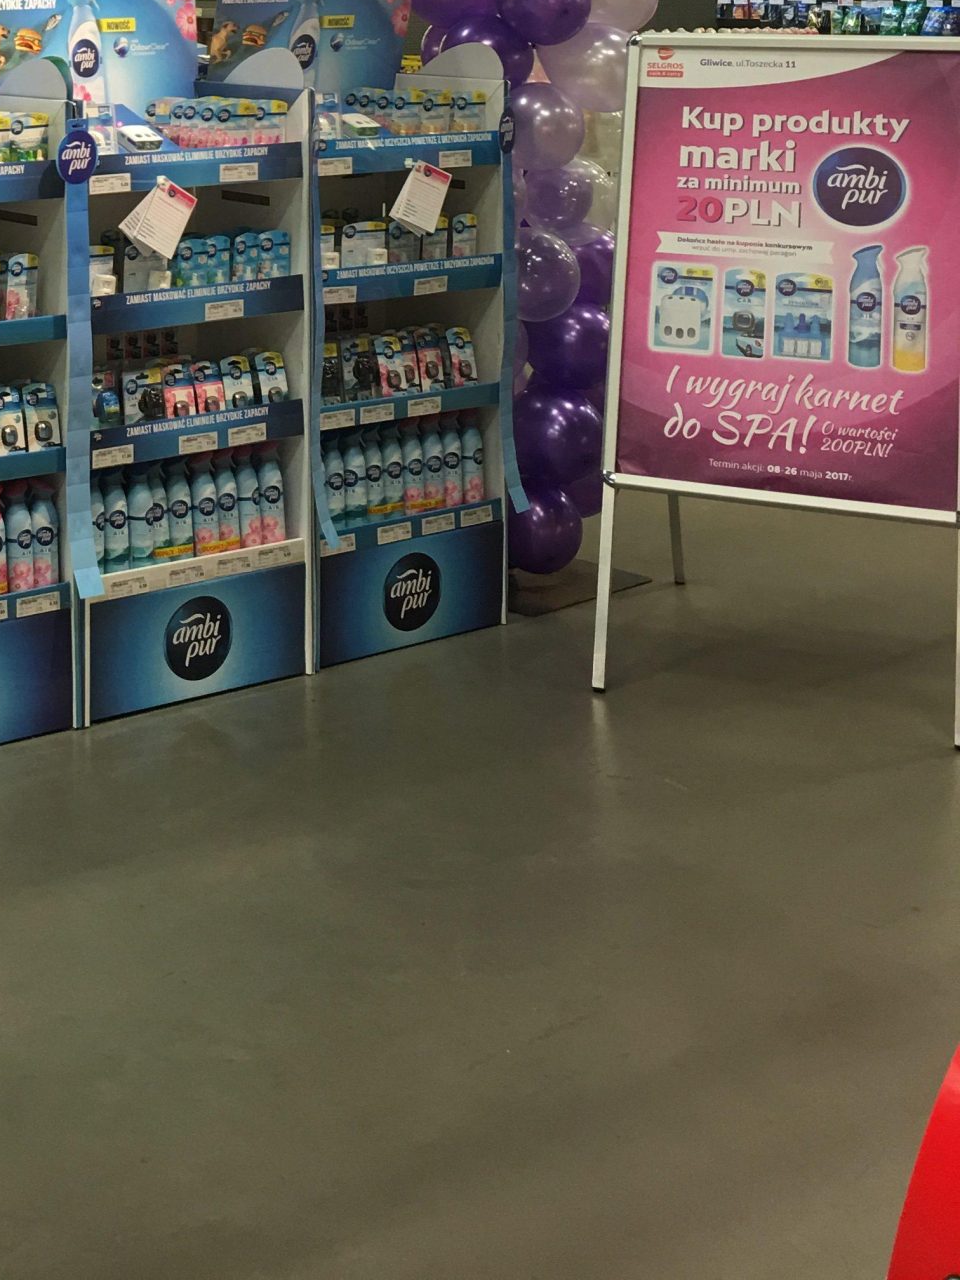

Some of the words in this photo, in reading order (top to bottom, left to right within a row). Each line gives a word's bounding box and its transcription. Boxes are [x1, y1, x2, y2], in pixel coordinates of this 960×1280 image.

[74, 48, 96, 63] ambi
[80, 59, 95, 73] pur
[785, 60, 796, 68] 11
[681, 106, 744, 136] Kup
[752, 109, 910, 143] produkty
[61, 141, 91, 160] ambi
[125, 155, 151, 165] ZAMIAST
[244, 147, 268, 157] ZAPACHY
[679, 139, 797, 172] marki
[69, 156, 92, 175] pur
[676, 176, 700, 190] za
[704, 174, 801, 195] minimum
[826, 165, 888, 190] ambi
[841, 186, 888, 210] pur
[676, 195, 803, 228] 20PLN
[765, 241, 813, 251] konkursowym
[126, 294, 153, 305] ZAMIAST
[246, 280, 271, 291] ZAPACHY
[666, 364, 681, 393] I
[686, 374, 795, 414] wygraj
[795, 373, 904, 415] karnet
[126, 425, 153, 437] ZAMIAST
[663, 402, 701, 439] do
[712, 411, 817, 455] SPA!
[837, 424, 898, 441] wartości
[820, 437, 894, 458] 200PLN!
[708, 458, 740, 470] Termin
[741, 461, 765, 473] akcji:
[800, 470, 823, 481] maja
[390, 569, 432, 599] ambi
[401, 588, 433, 619] pur
[172, 613, 221, 645] ambi
[185, 634, 221, 667] pur
